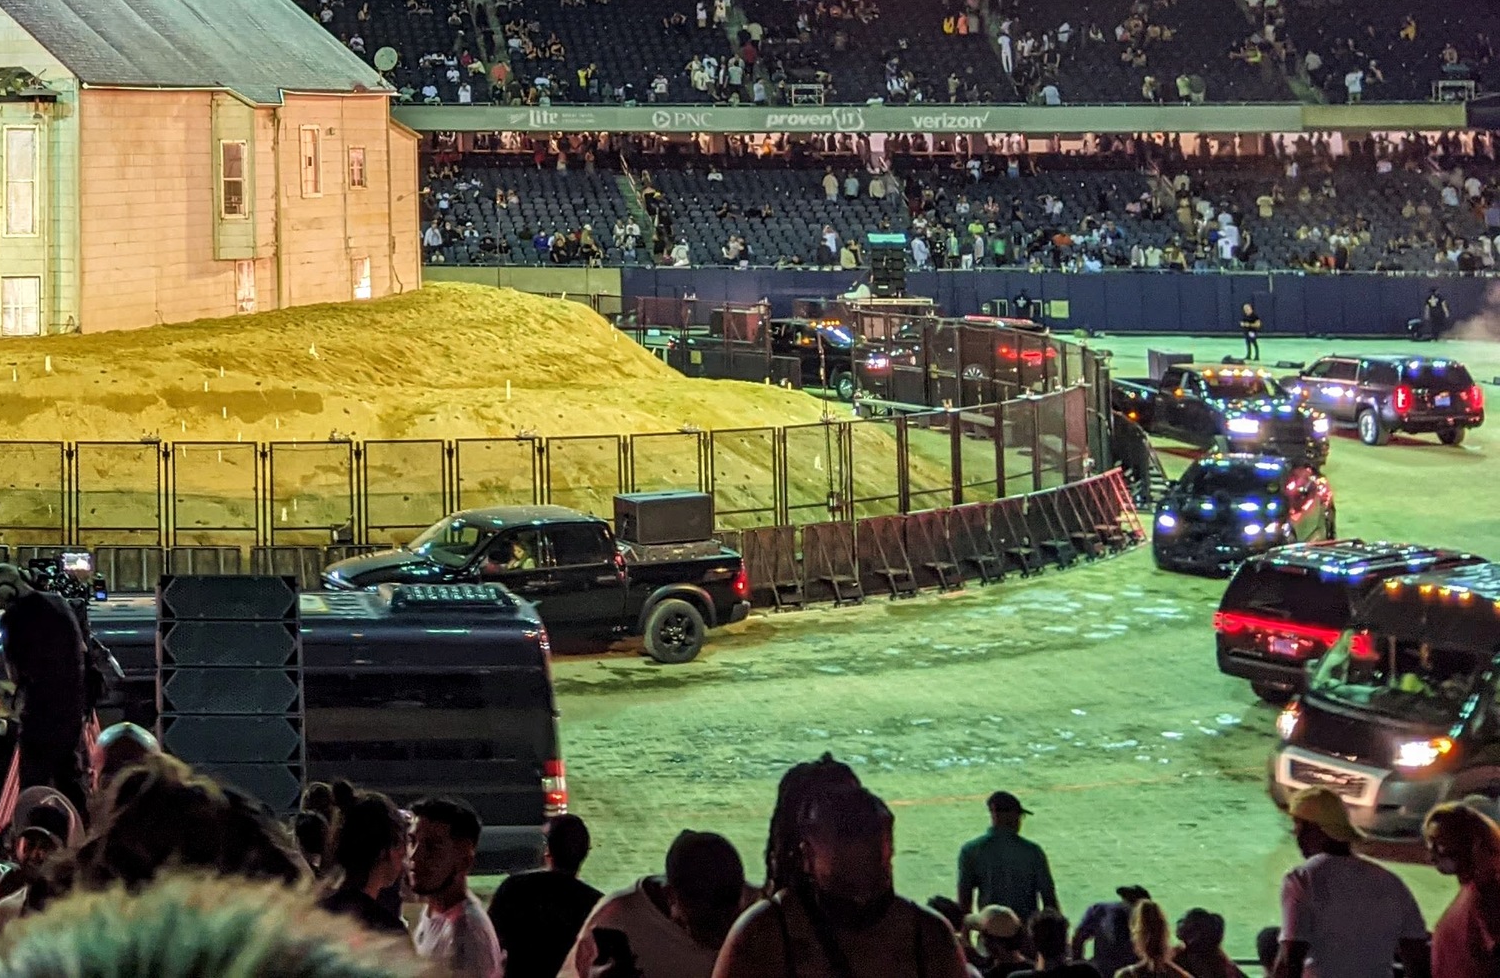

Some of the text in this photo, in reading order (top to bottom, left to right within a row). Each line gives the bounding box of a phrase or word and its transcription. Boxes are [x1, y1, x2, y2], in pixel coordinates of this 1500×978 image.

[529, 110, 559, 128] Lite
[674, 112, 713, 127] PNC
[911, 112, 982, 129] verizon
